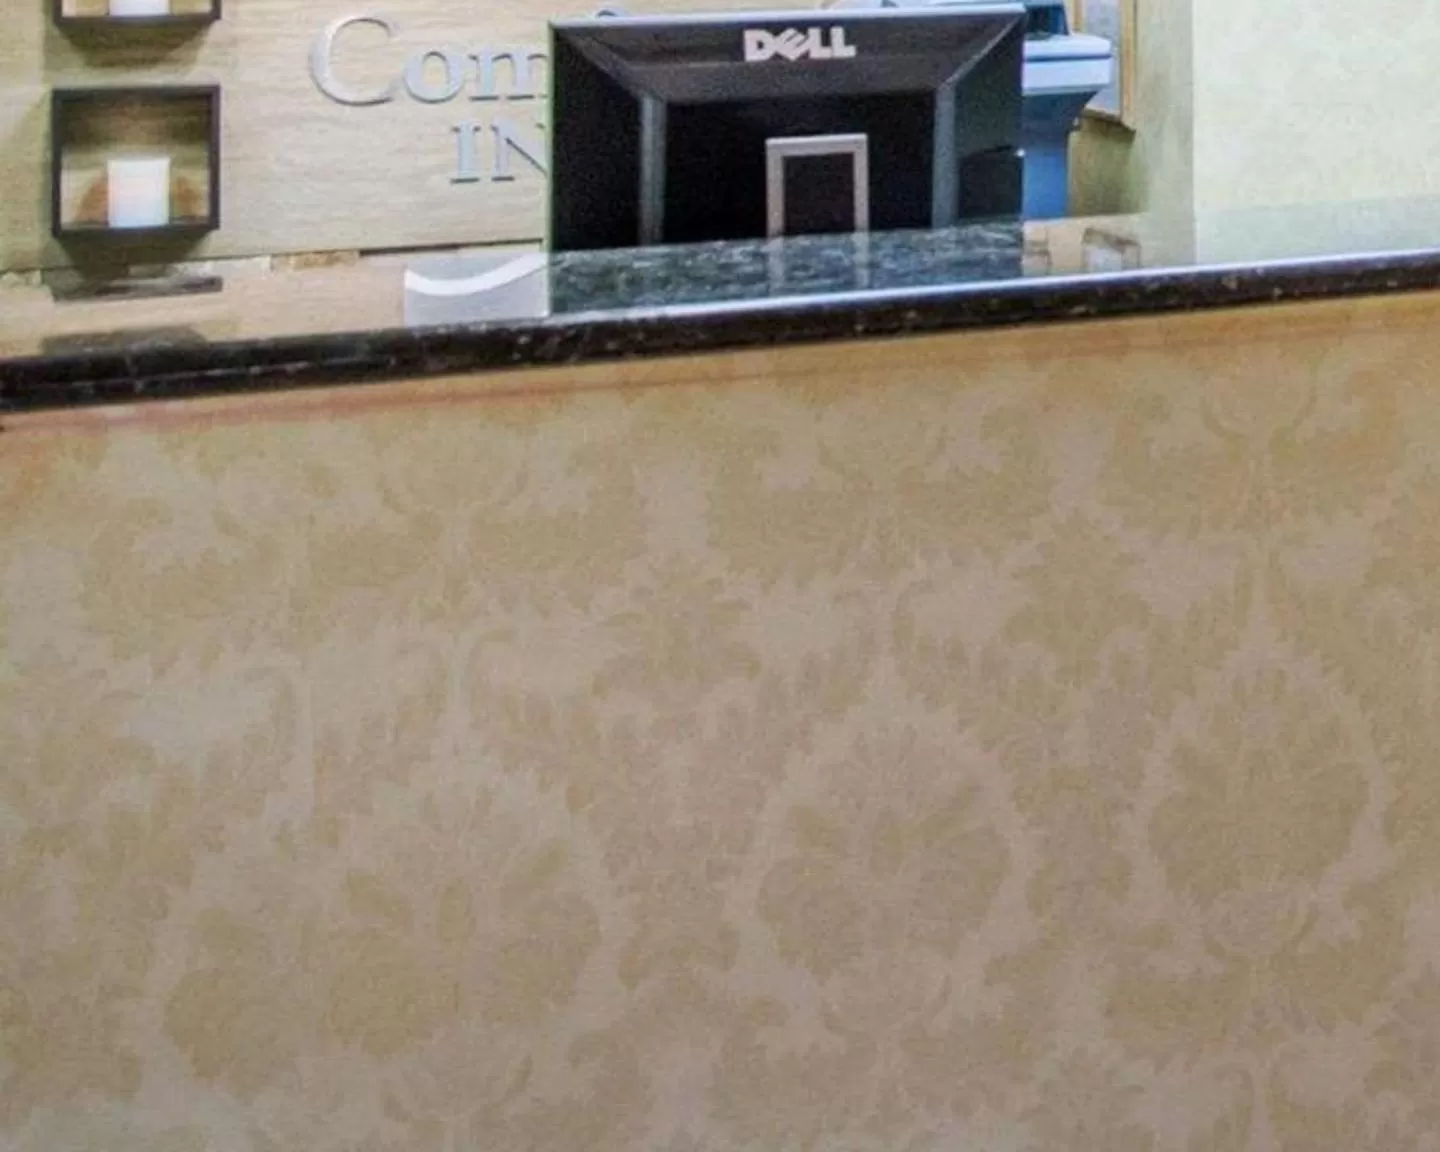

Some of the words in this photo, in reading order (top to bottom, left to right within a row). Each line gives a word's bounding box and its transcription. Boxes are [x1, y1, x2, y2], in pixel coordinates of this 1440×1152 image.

[309, 8, 549, 106] Com
[743, 26, 857, 62] DELL
[450, 117, 549, 183] IN
